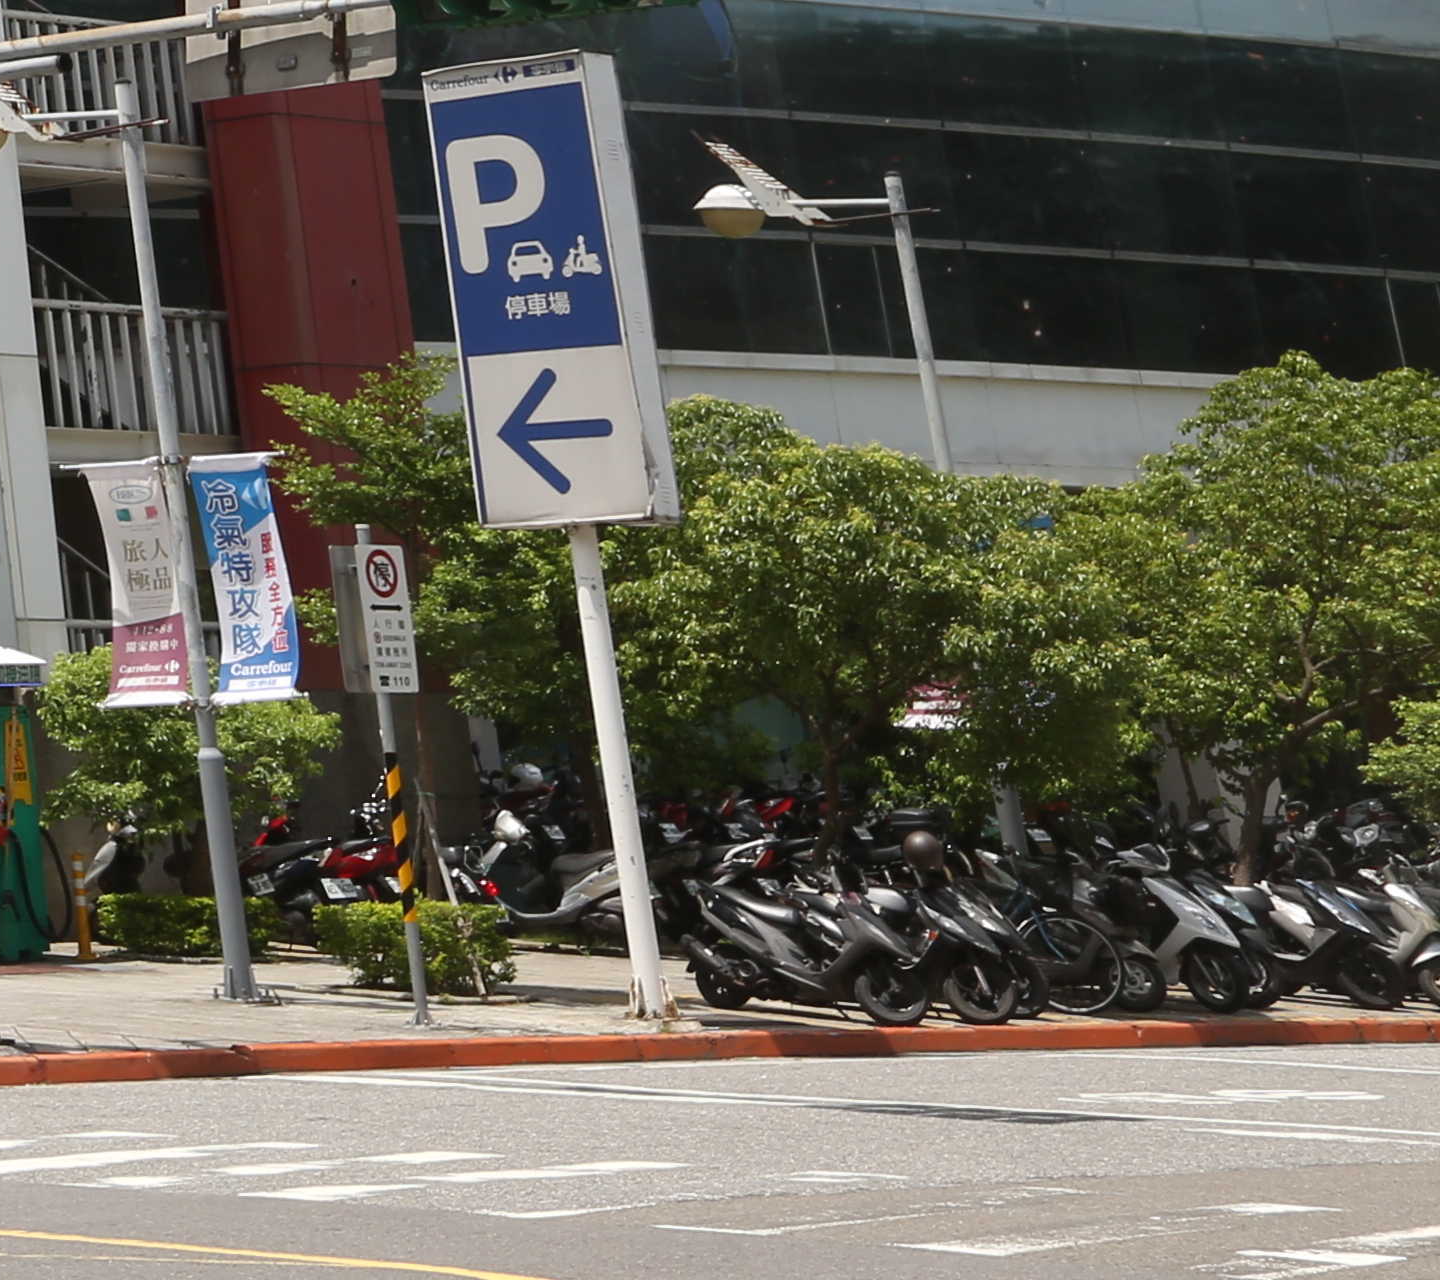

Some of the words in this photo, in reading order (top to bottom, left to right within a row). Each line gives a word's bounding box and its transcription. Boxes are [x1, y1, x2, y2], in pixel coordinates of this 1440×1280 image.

[430, 74, 488, 90] Carrefour
[445, 135, 545, 275] P
[504, 290, 571, 320] 停車場
[122, 538, 168, 563] 旅人
[126, 566, 172, 592] 極品
[202, 479, 266, 656] 冷氣特攻隊
[261, 532, 288, 653] 服務全方位
[119, 663, 162, 674] Carrefour
[231, 660, 292, 676] Carrefour
[393, 676, 410, 686] 110
